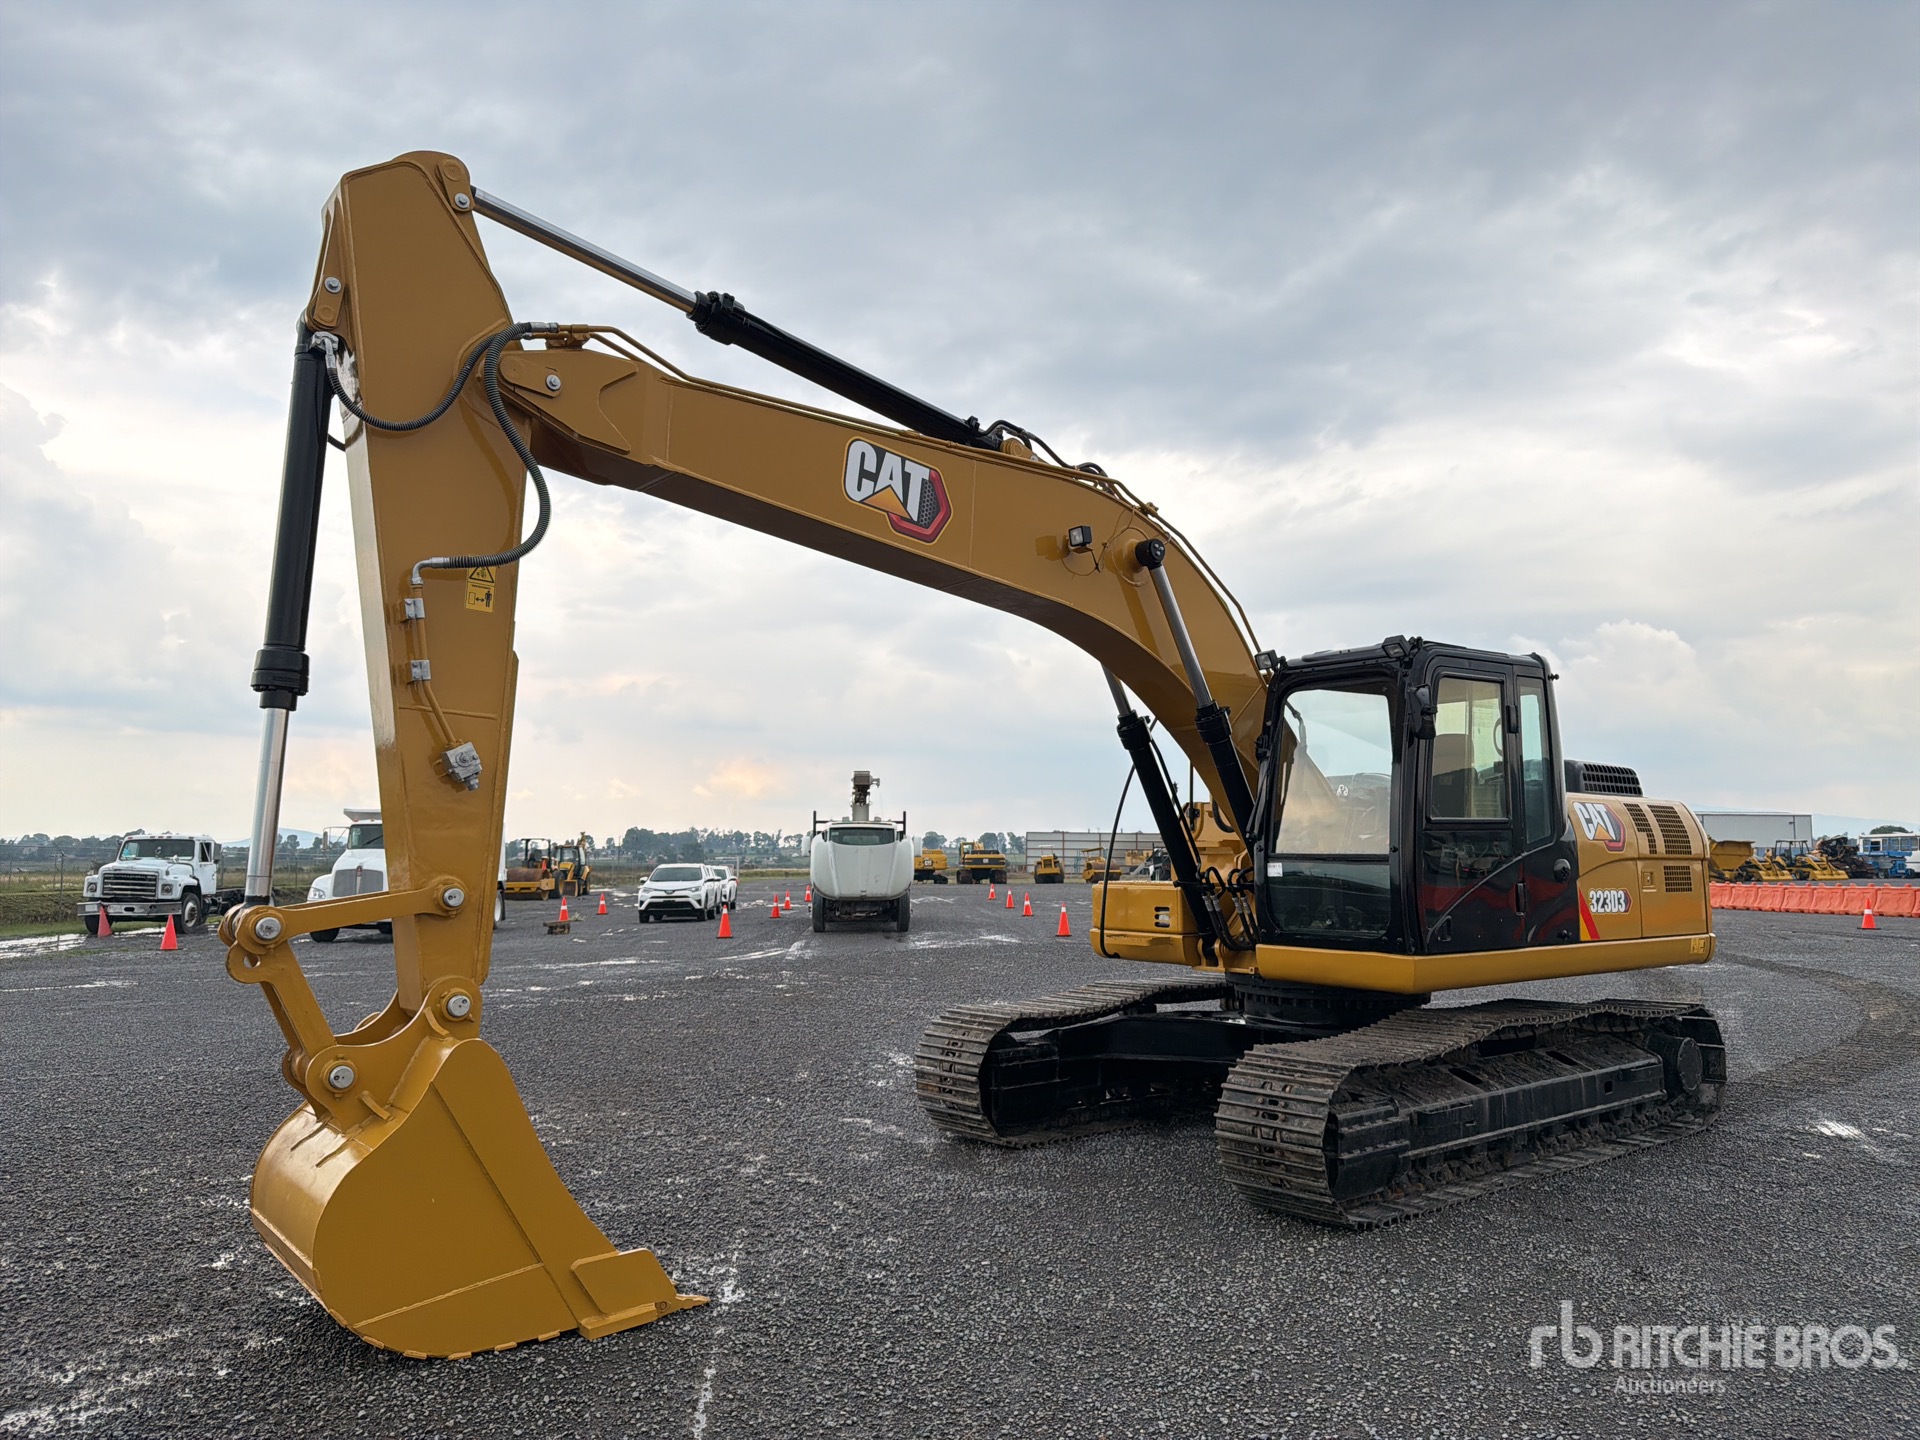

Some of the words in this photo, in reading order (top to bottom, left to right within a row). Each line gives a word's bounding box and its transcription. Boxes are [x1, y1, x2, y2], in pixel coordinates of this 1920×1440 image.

[845, 439, 931, 522] CAT
[1573, 801, 1617, 841] CAT
[1589, 889, 1627, 914] 323D3
